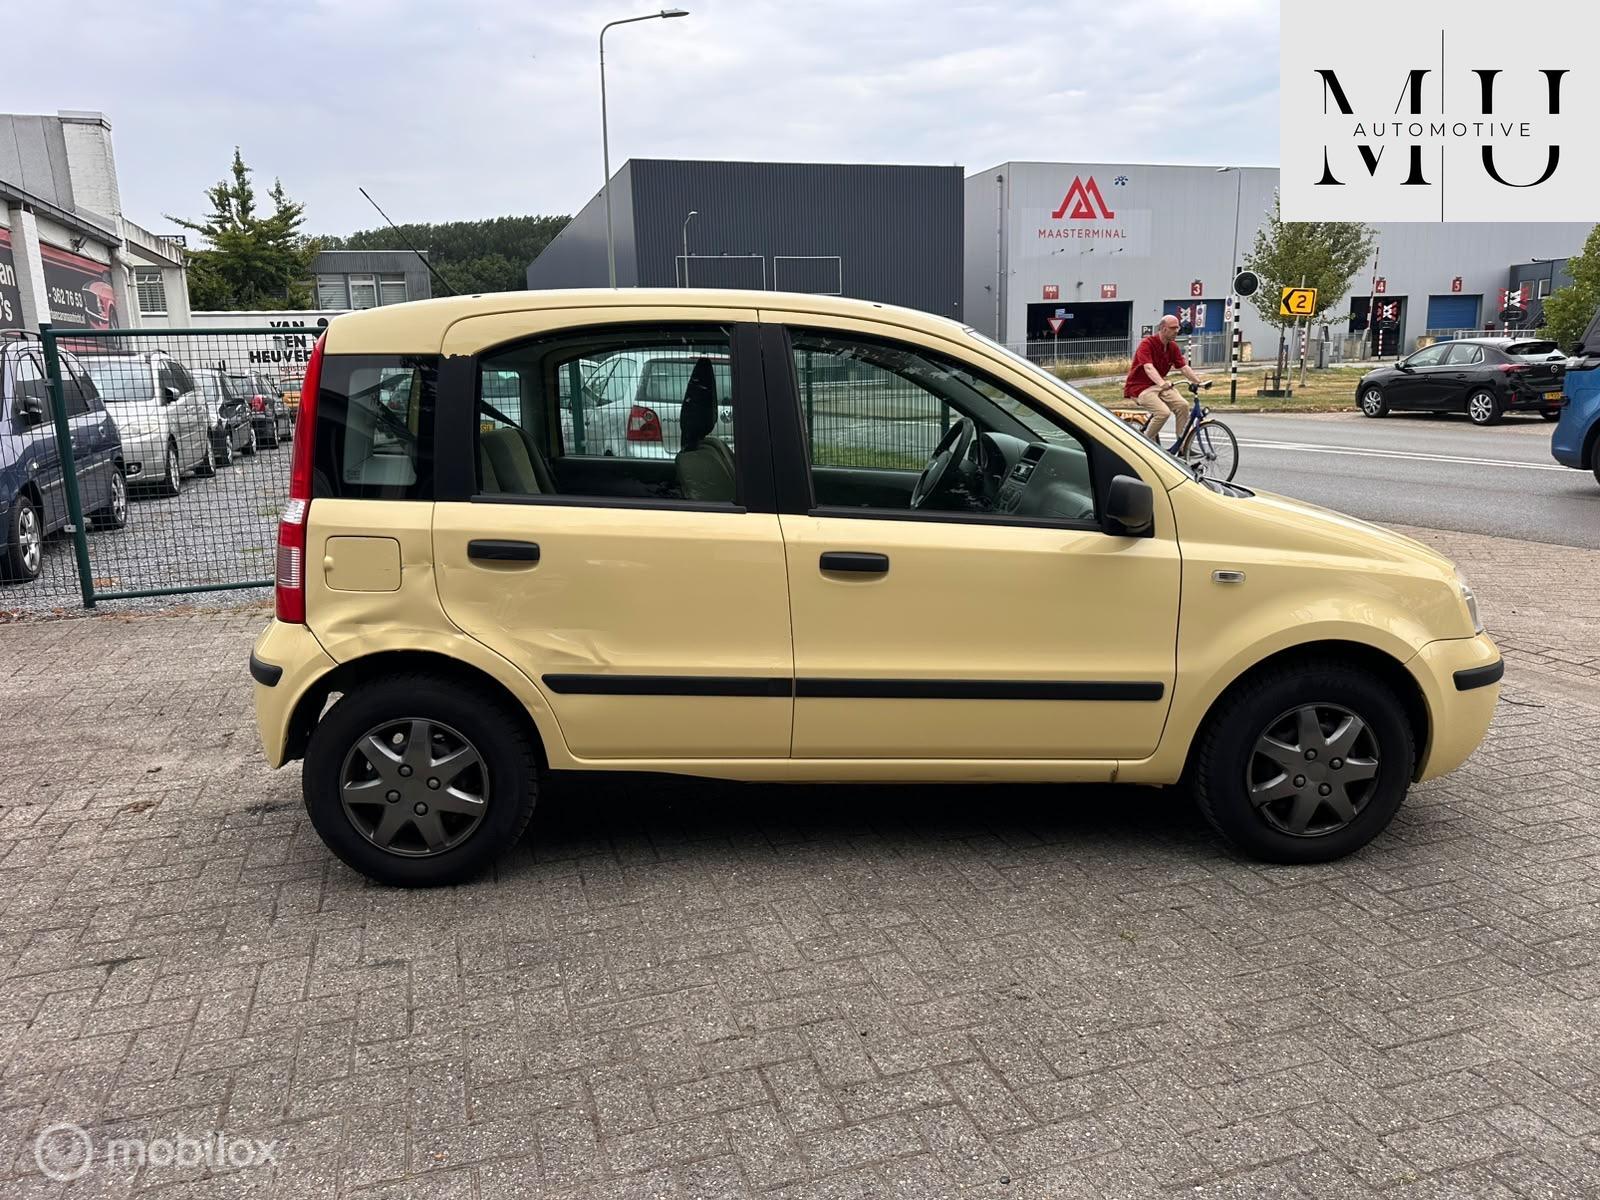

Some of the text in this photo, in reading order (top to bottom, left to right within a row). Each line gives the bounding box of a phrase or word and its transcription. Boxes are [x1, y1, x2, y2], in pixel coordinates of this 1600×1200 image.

[1038, 228, 1127, 239] MAASTERMINAL
[1193, 283, 1201, 295] 3
[1377, 281, 1384, 292] 4
[1454, 281, 1461, 291] 5
[52, 286, 66, 305] 362
[65, 289, 75, 307] 76
[74, 291, 84, 308] 53
[1296, 294, 1307, 309] 2
[269, 320, 305, 328] VAN
